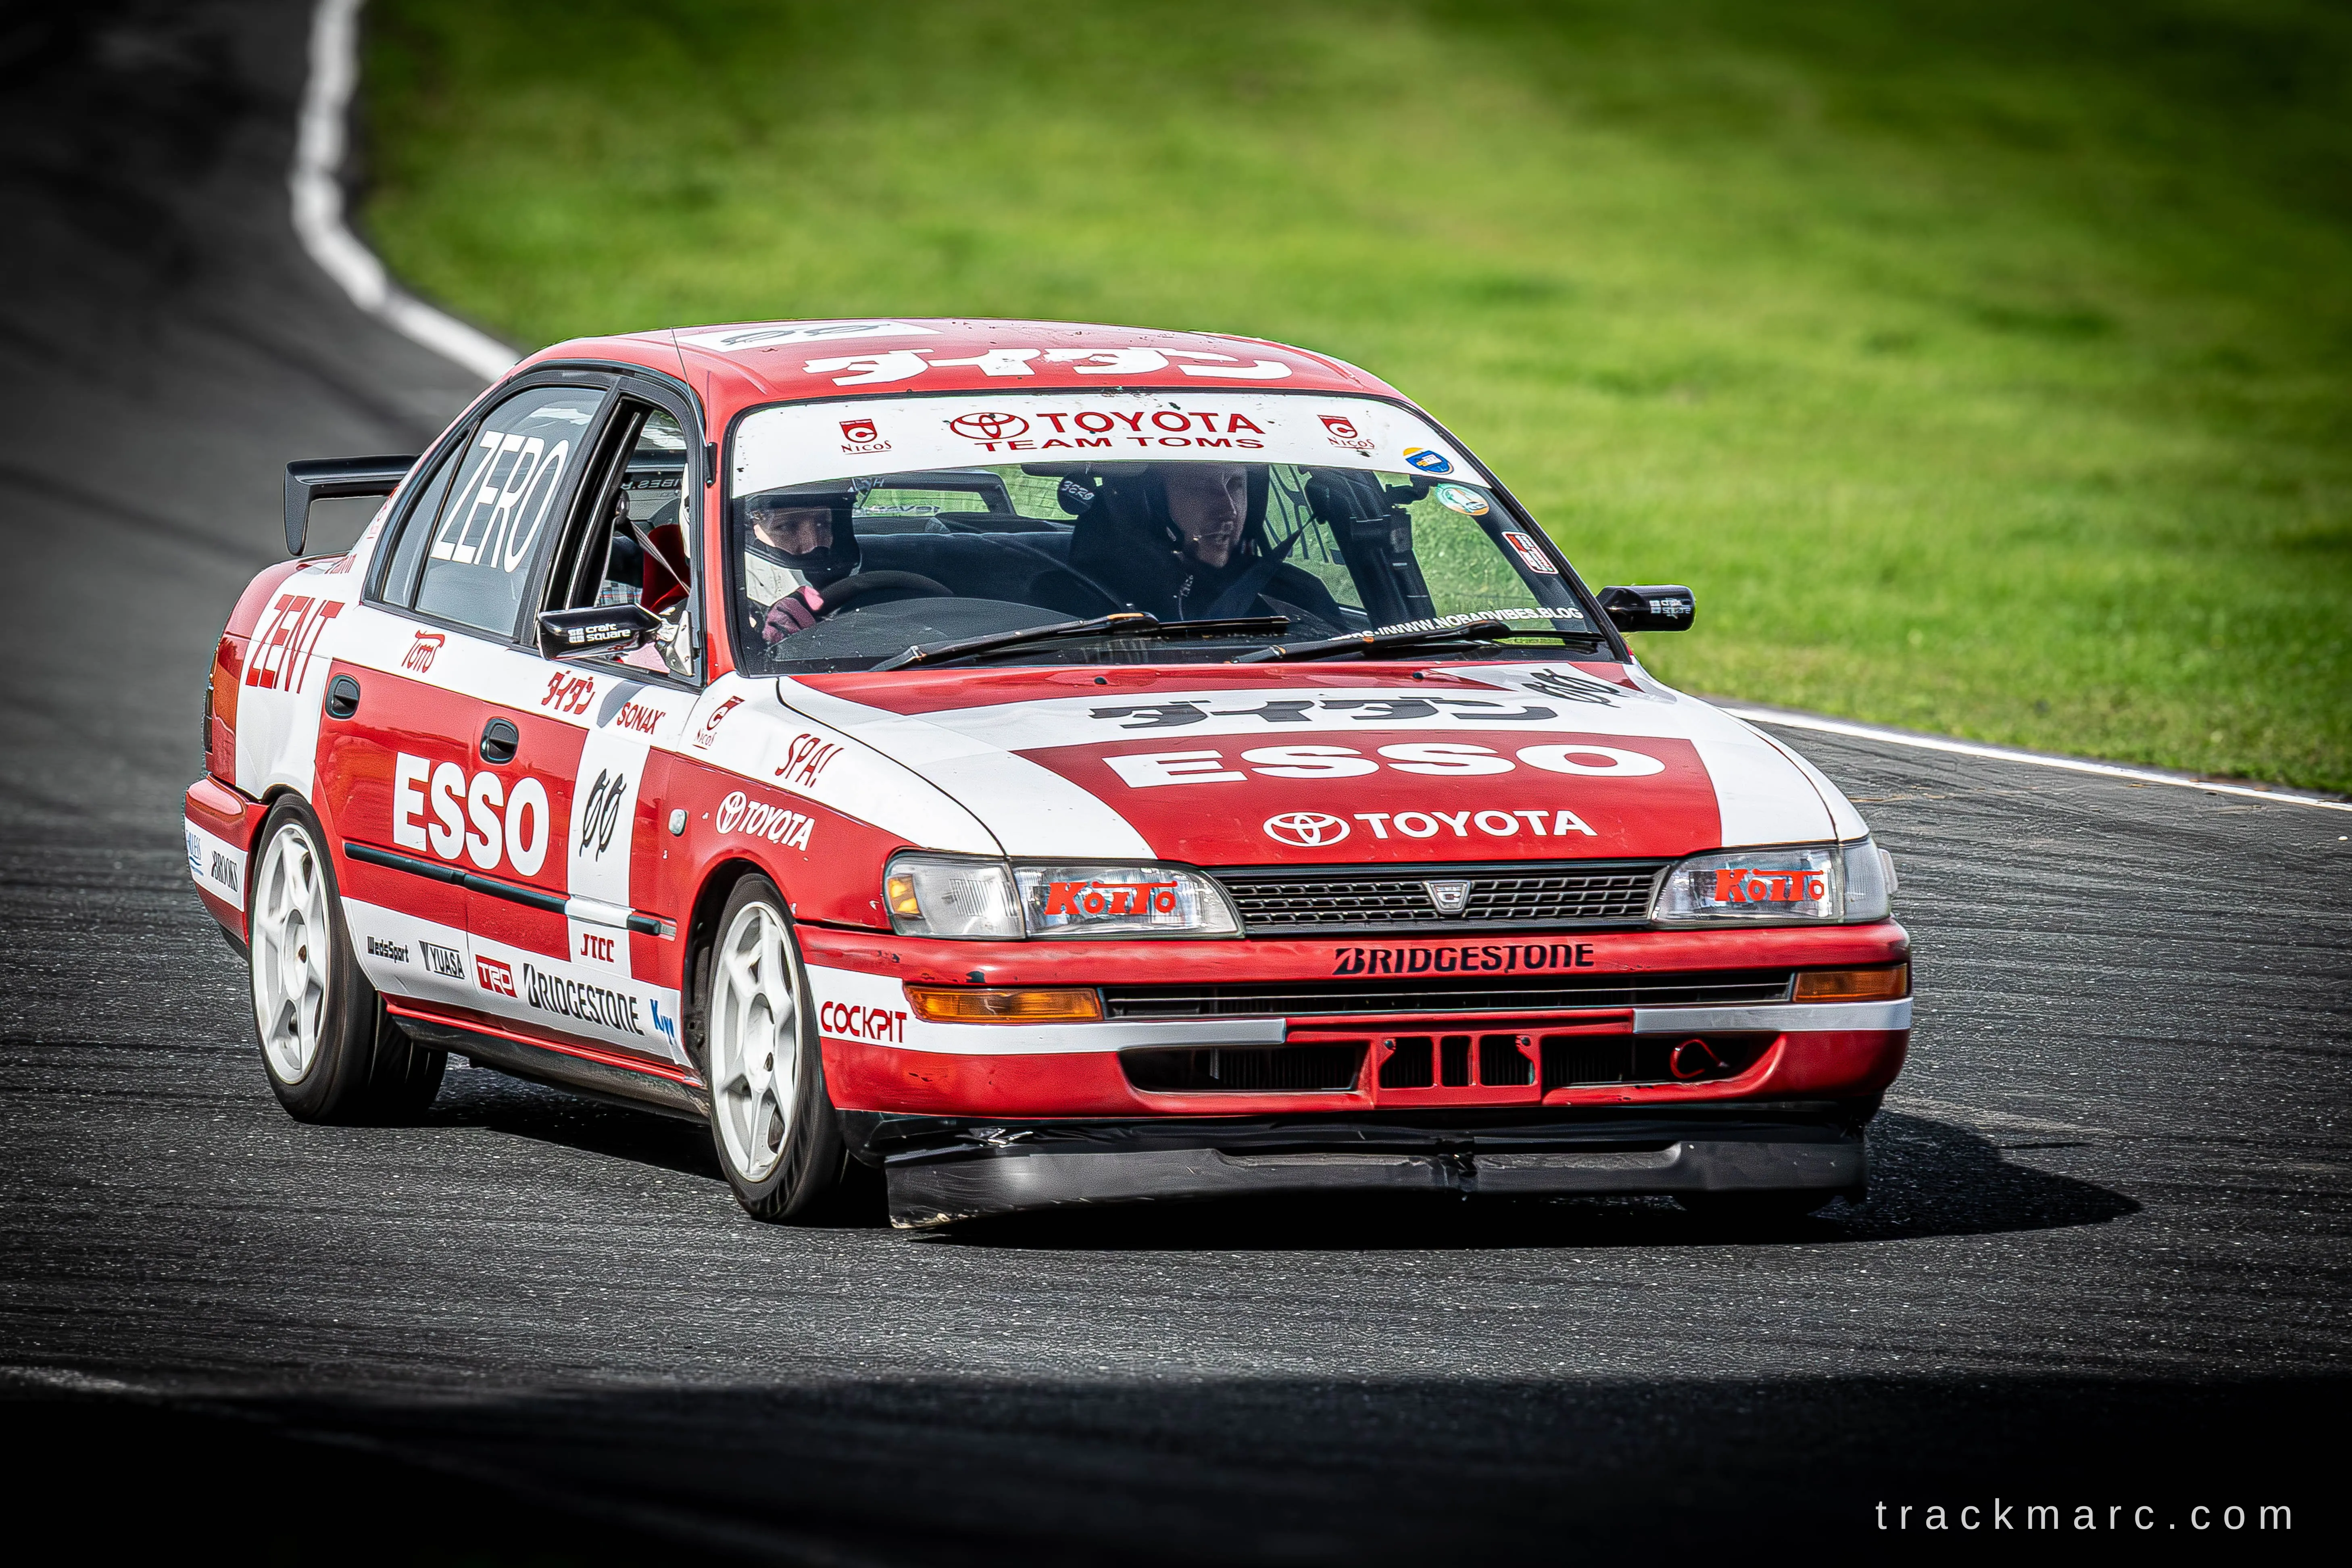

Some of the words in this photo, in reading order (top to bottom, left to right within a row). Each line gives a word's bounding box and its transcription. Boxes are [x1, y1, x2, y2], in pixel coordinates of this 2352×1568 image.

[1036, 411, 1266, 434] TOYOTA
[974, 437, 1113, 452] TEAM
[1126, 437, 1265, 448] TOMS
[430, 430, 569, 573] ZERO
[246, 594, 345, 694] ZENT
[586, 629, 631, 642] square
[1101, 742, 1666, 788] ESSO
[393, 752, 550, 877] ESSO
[737, 800, 815, 851] TOYOTA
[1353, 809, 1599, 840] TOYOTA
[429, 947, 465, 978] YUASA
[580, 933, 615, 963] JTCC
[1332, 943, 1594, 975] BRIDGESTONE
[476, 961, 514, 995] TRD
[523, 962, 645, 1036] BRIDGESTONE
[821, 1001, 907, 1043] COCKPIT
